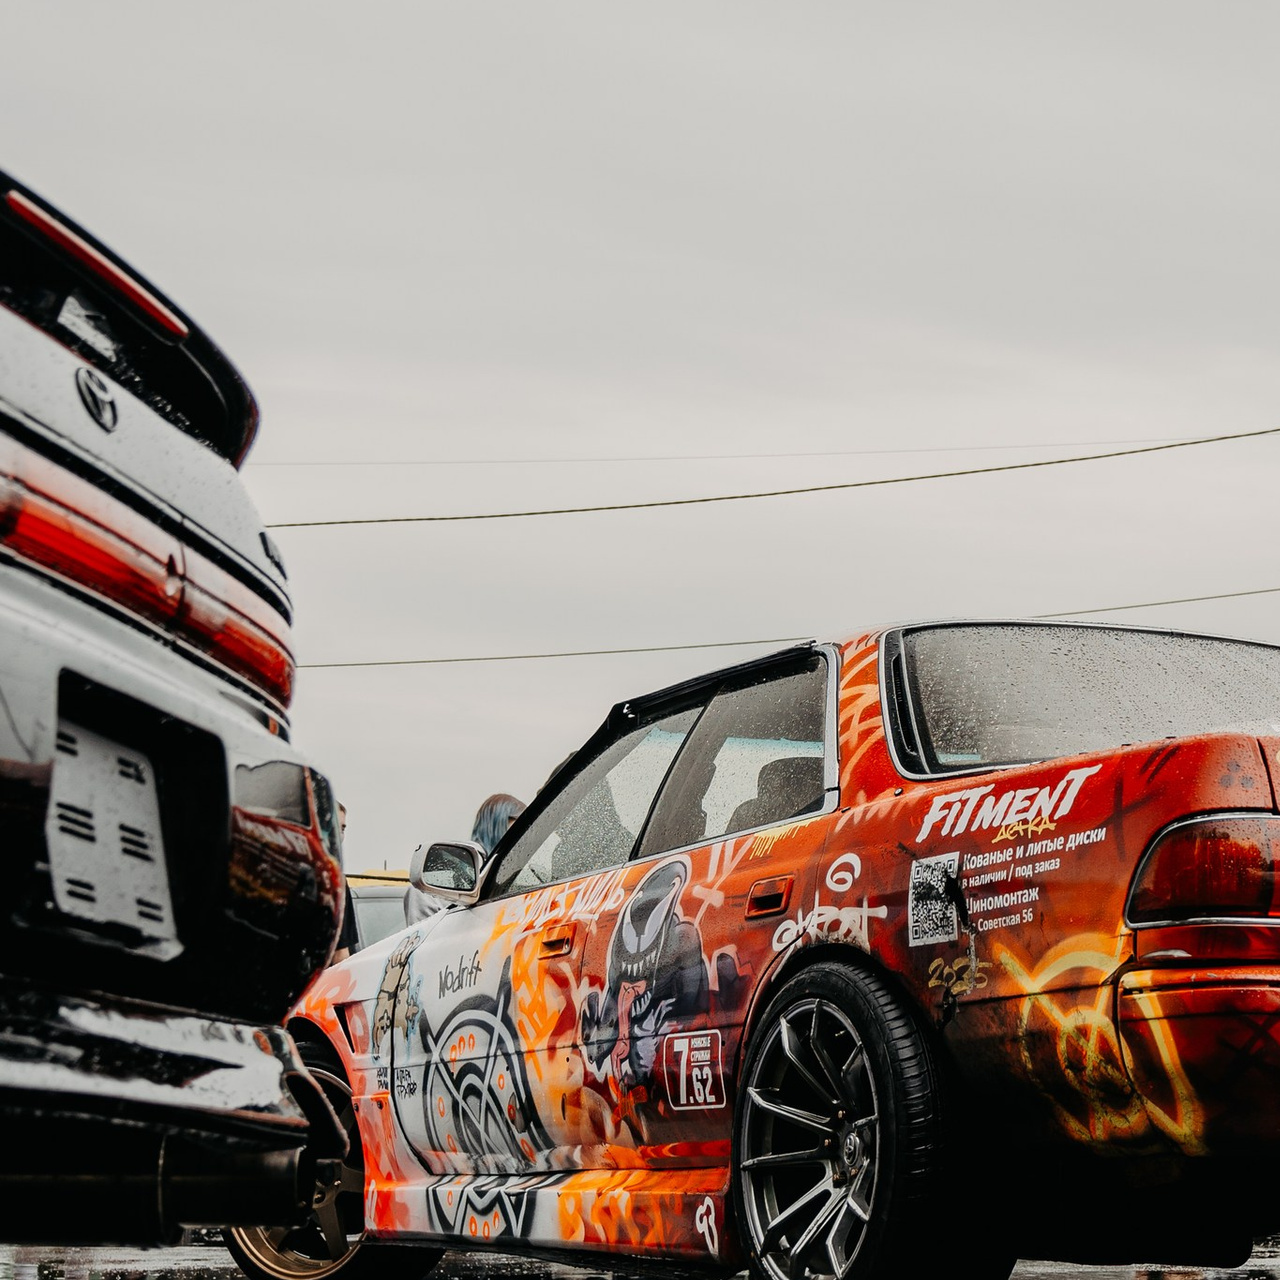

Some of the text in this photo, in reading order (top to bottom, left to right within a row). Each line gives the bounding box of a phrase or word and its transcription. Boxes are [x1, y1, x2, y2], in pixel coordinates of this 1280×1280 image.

[916, 763, 1103, 843] FITMENT
[963, 827, 1107, 871] Кованые и литые диски
[962, 878, 968, 889] в
[969, 869, 1007, 887] наличии
[1015, 864, 1033, 879] под
[1034, 858, 1060, 873] заказ
[978, 908, 1034, 932] Советская 56
